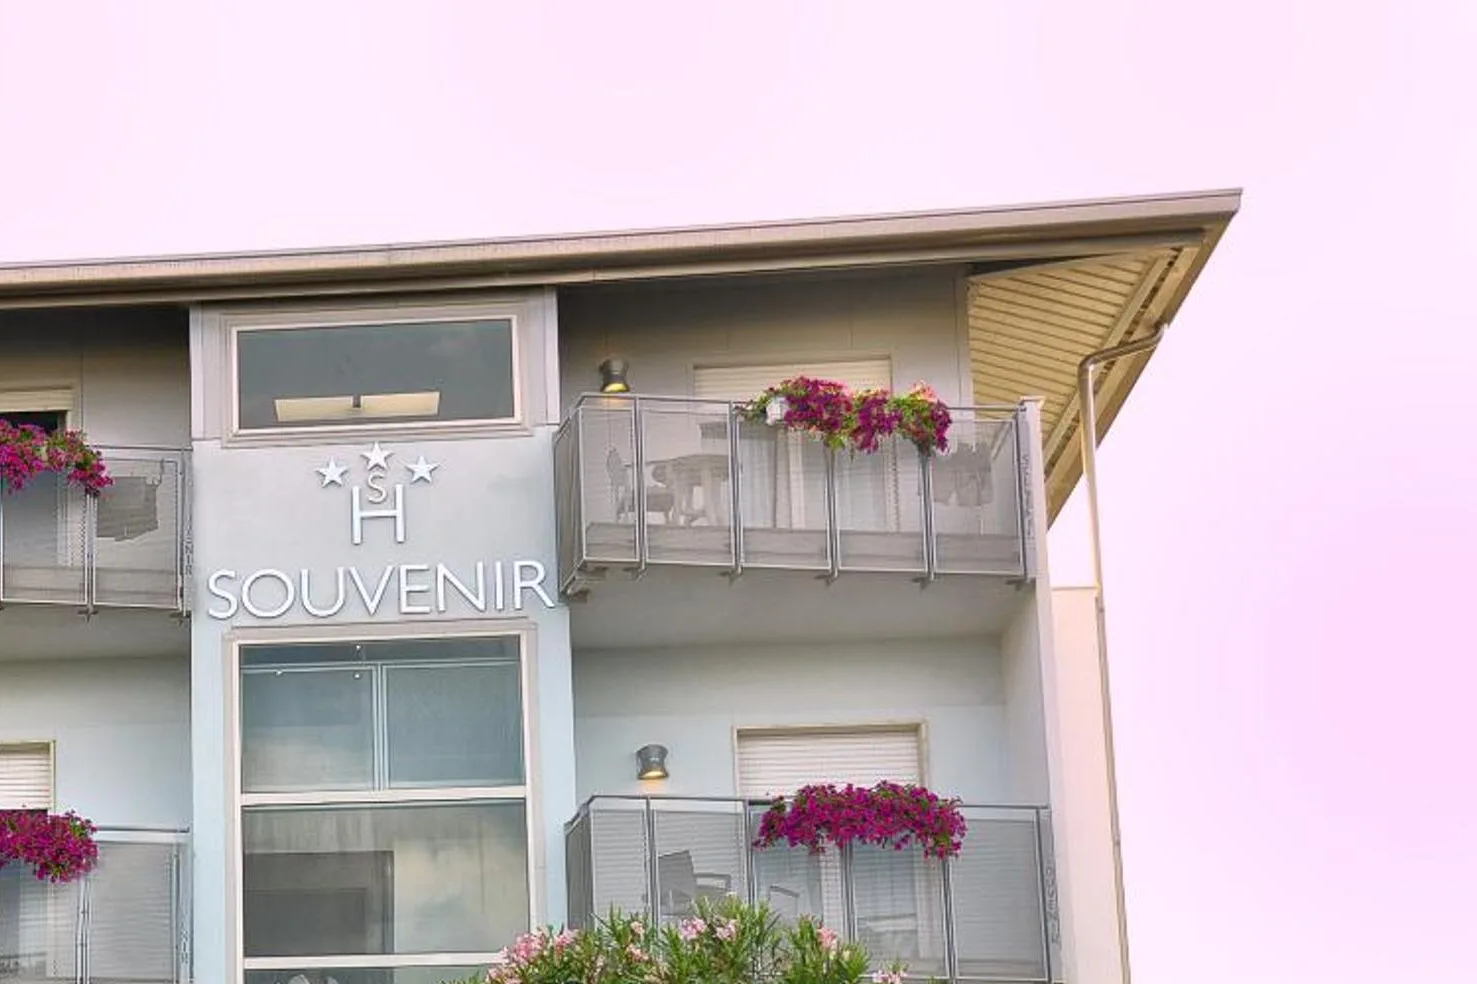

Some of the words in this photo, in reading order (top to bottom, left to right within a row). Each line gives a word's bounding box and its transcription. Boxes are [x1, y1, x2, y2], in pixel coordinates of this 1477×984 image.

[351, 484, 404, 545] H
[367, 472, 387, 503] S
[207, 561, 556, 619] SOUVENIR
